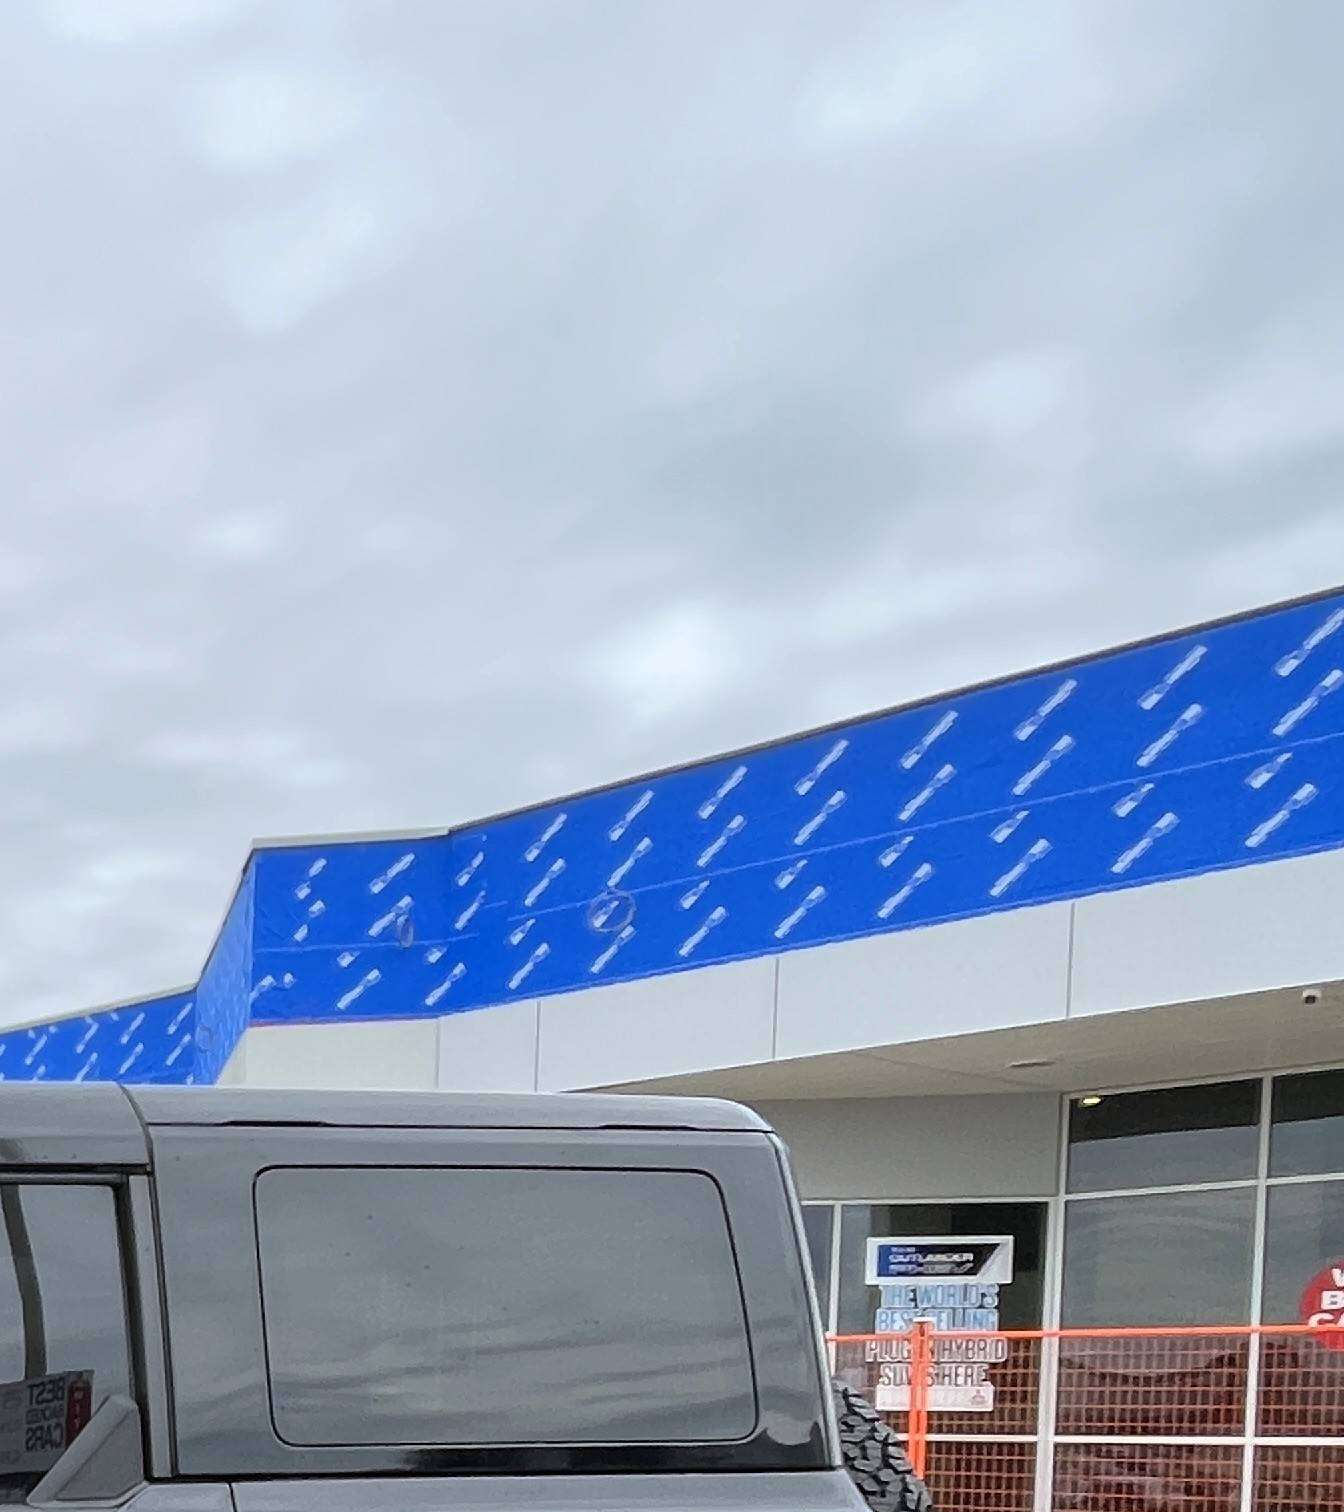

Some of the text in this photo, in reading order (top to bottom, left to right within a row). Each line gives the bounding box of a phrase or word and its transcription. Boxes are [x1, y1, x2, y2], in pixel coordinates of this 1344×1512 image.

[940, 1338, 1005, 1360] HYBRID
[881, 1364, 912, 1386] SU
[939, 1364, 987, 1386] HERE
